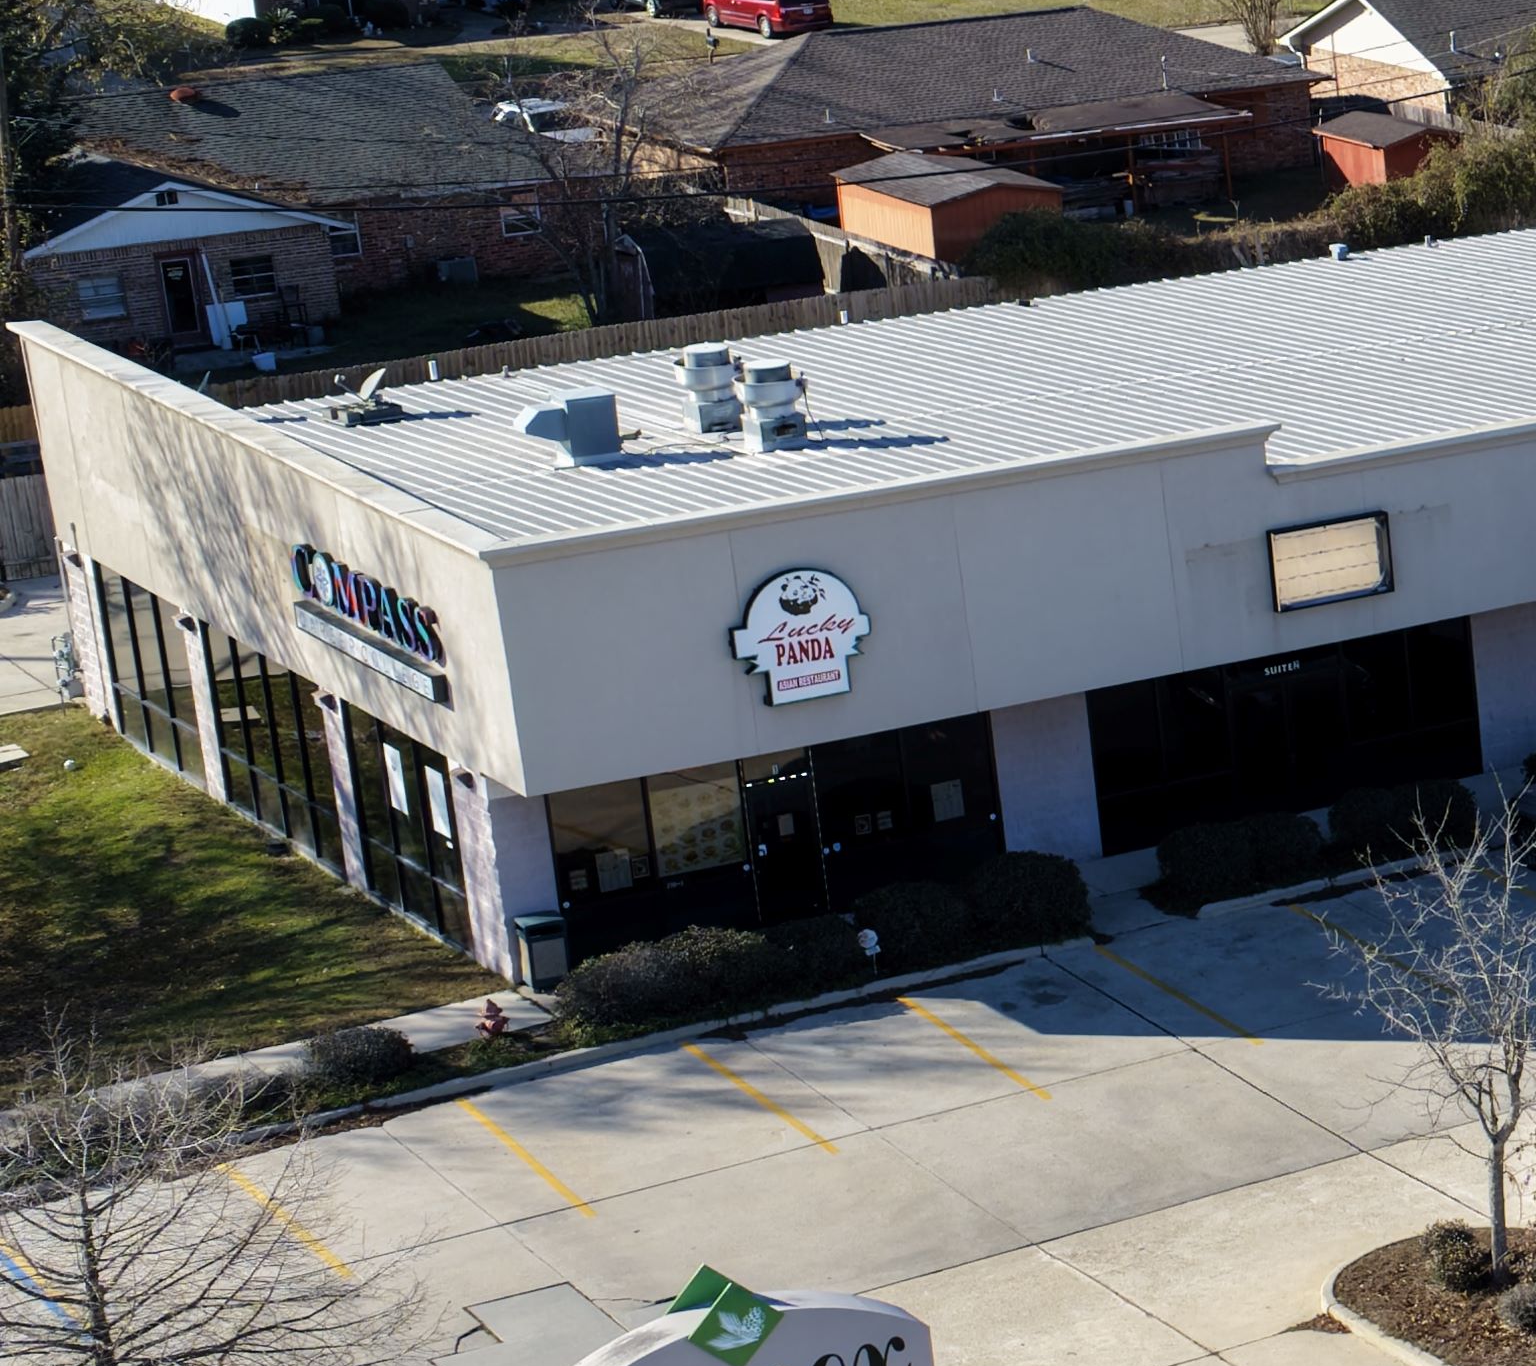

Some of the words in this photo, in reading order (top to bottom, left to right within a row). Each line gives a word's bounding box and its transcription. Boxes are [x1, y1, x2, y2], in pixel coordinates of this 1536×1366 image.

[290, 543, 440, 665] COMPASS
[757, 613, 856, 644] Lucky
[775, 636, 835, 667] PANDA
